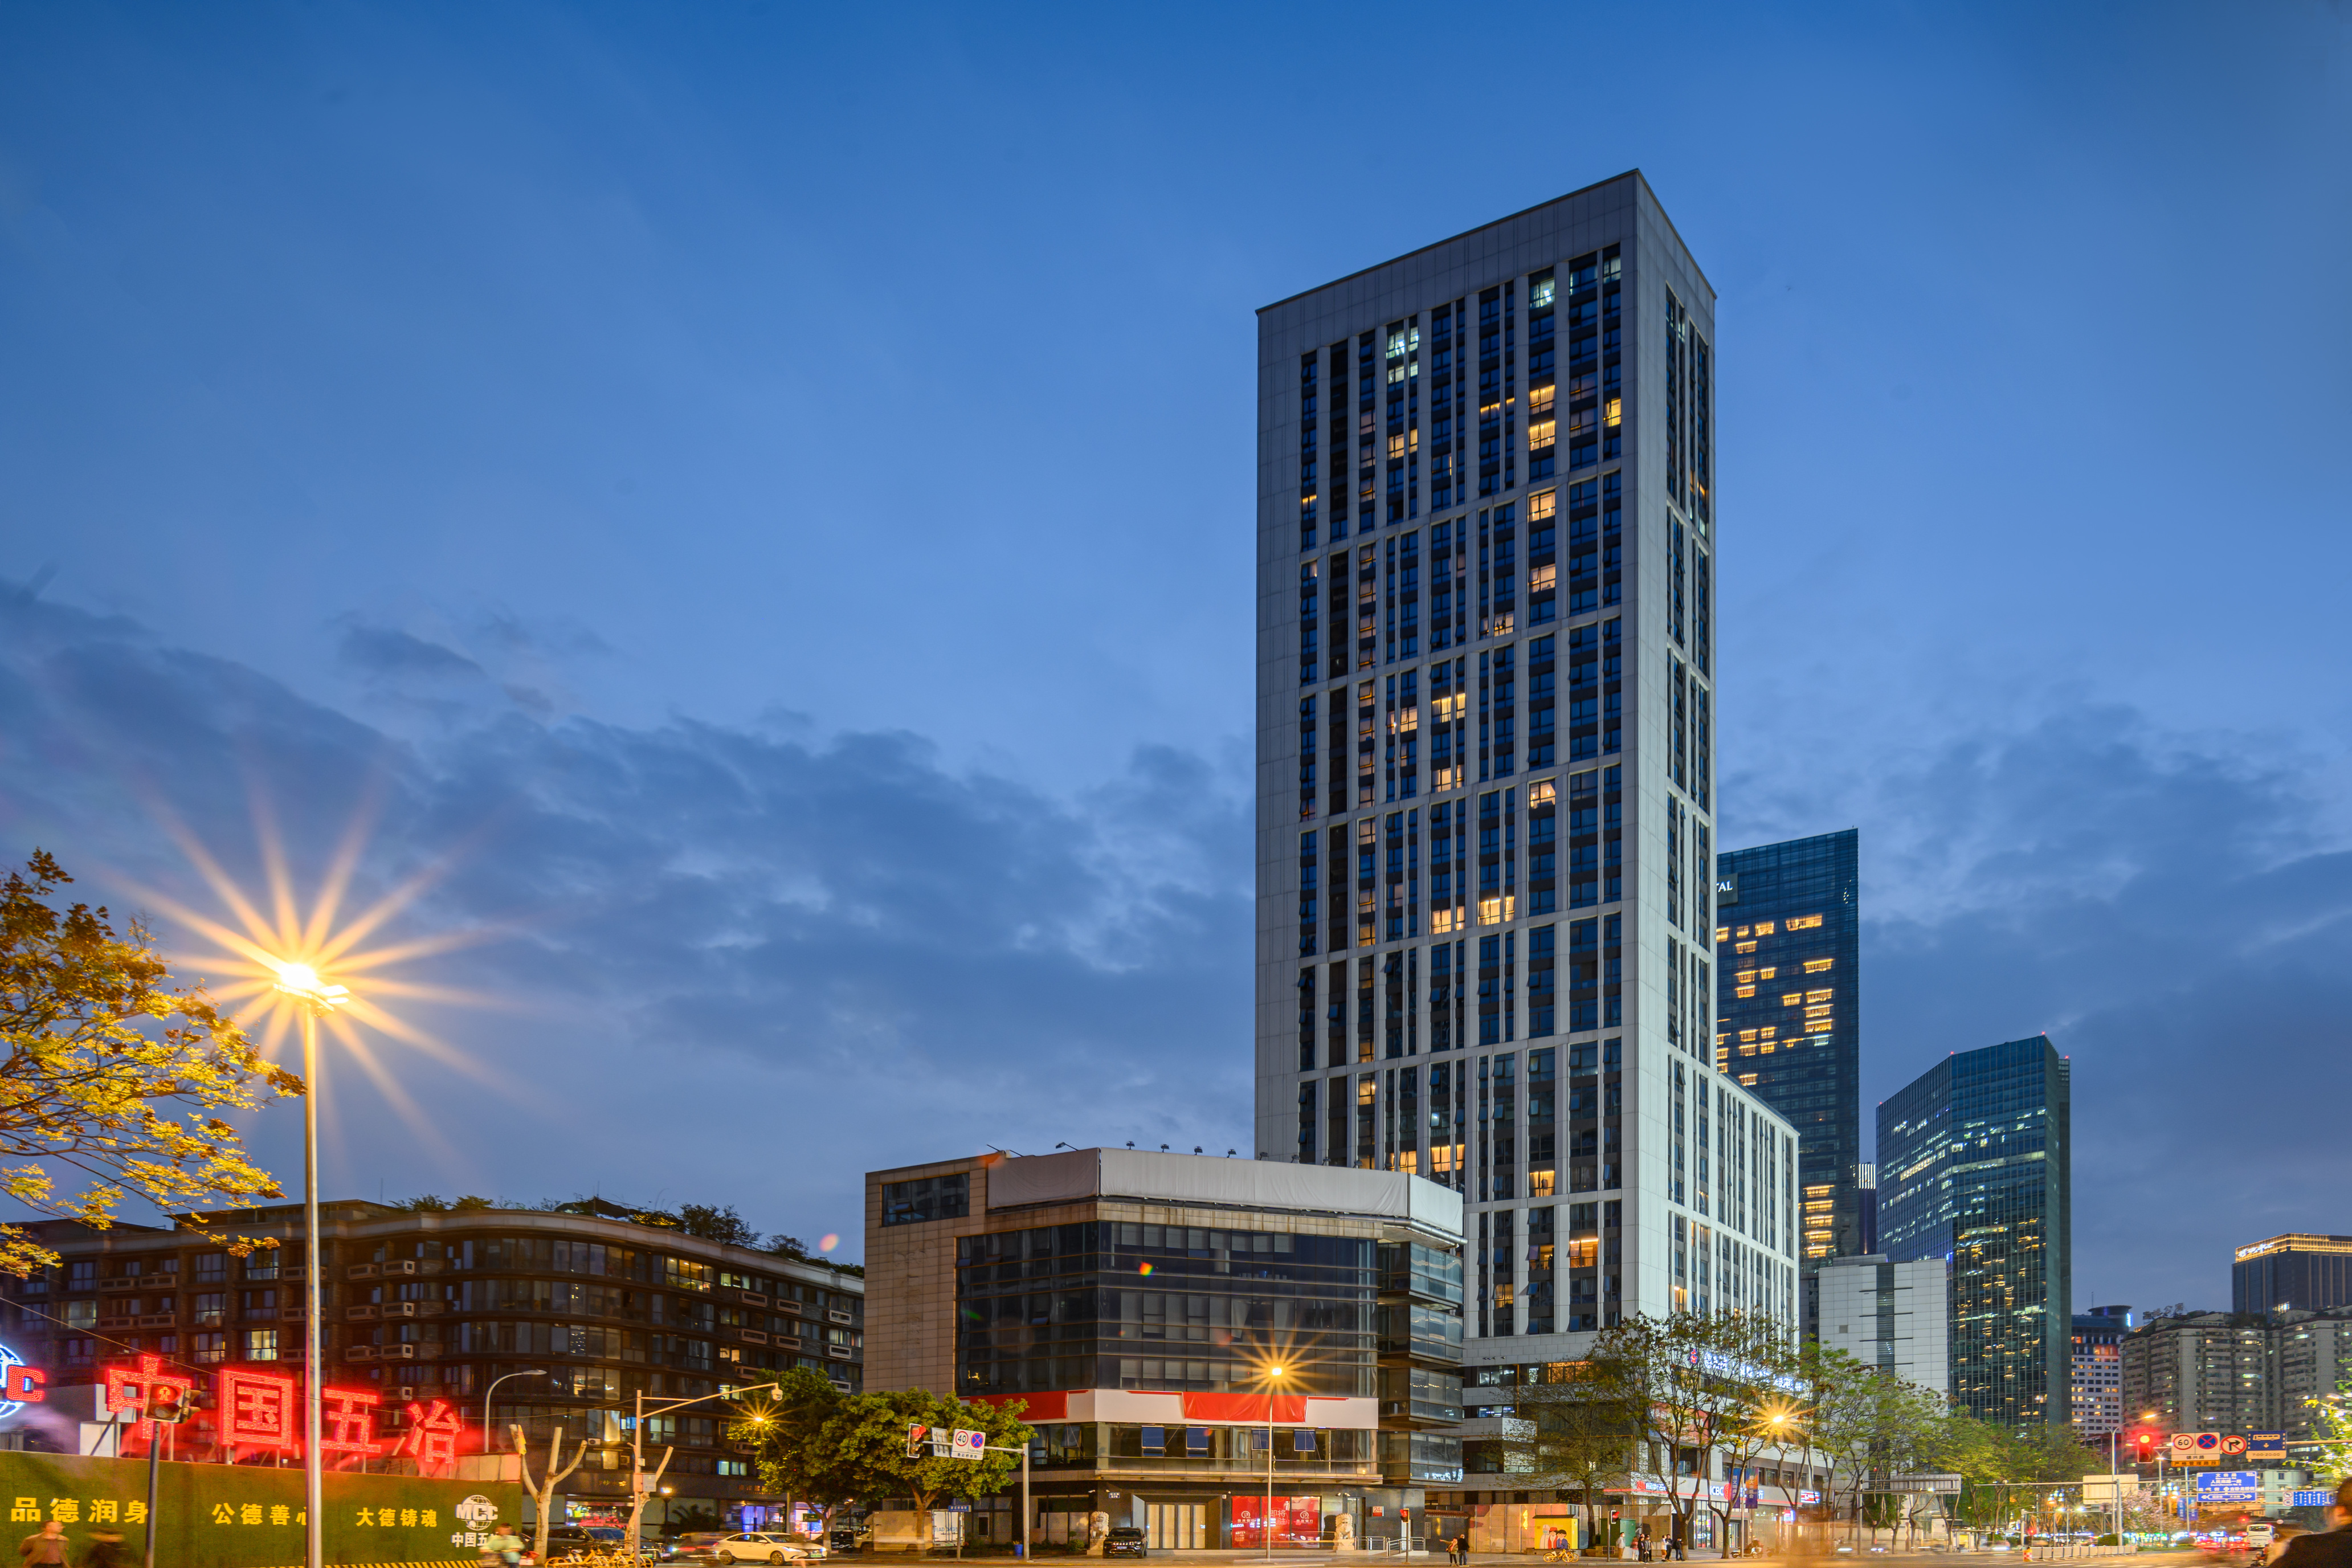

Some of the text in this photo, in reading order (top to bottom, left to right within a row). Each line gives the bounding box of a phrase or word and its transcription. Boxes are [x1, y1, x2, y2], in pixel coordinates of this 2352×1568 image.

[108, 1355, 460, 1464] 中国五冶
[1709, 1485, 1724, 1496] ICBC
[11, 1497, 149, 1524] 品德润身
[356, 1507, 437, 1527] 大德铸魂
[456, 1504, 499, 1521] MCC
[451, 1532, 497, 1547] 中国五
